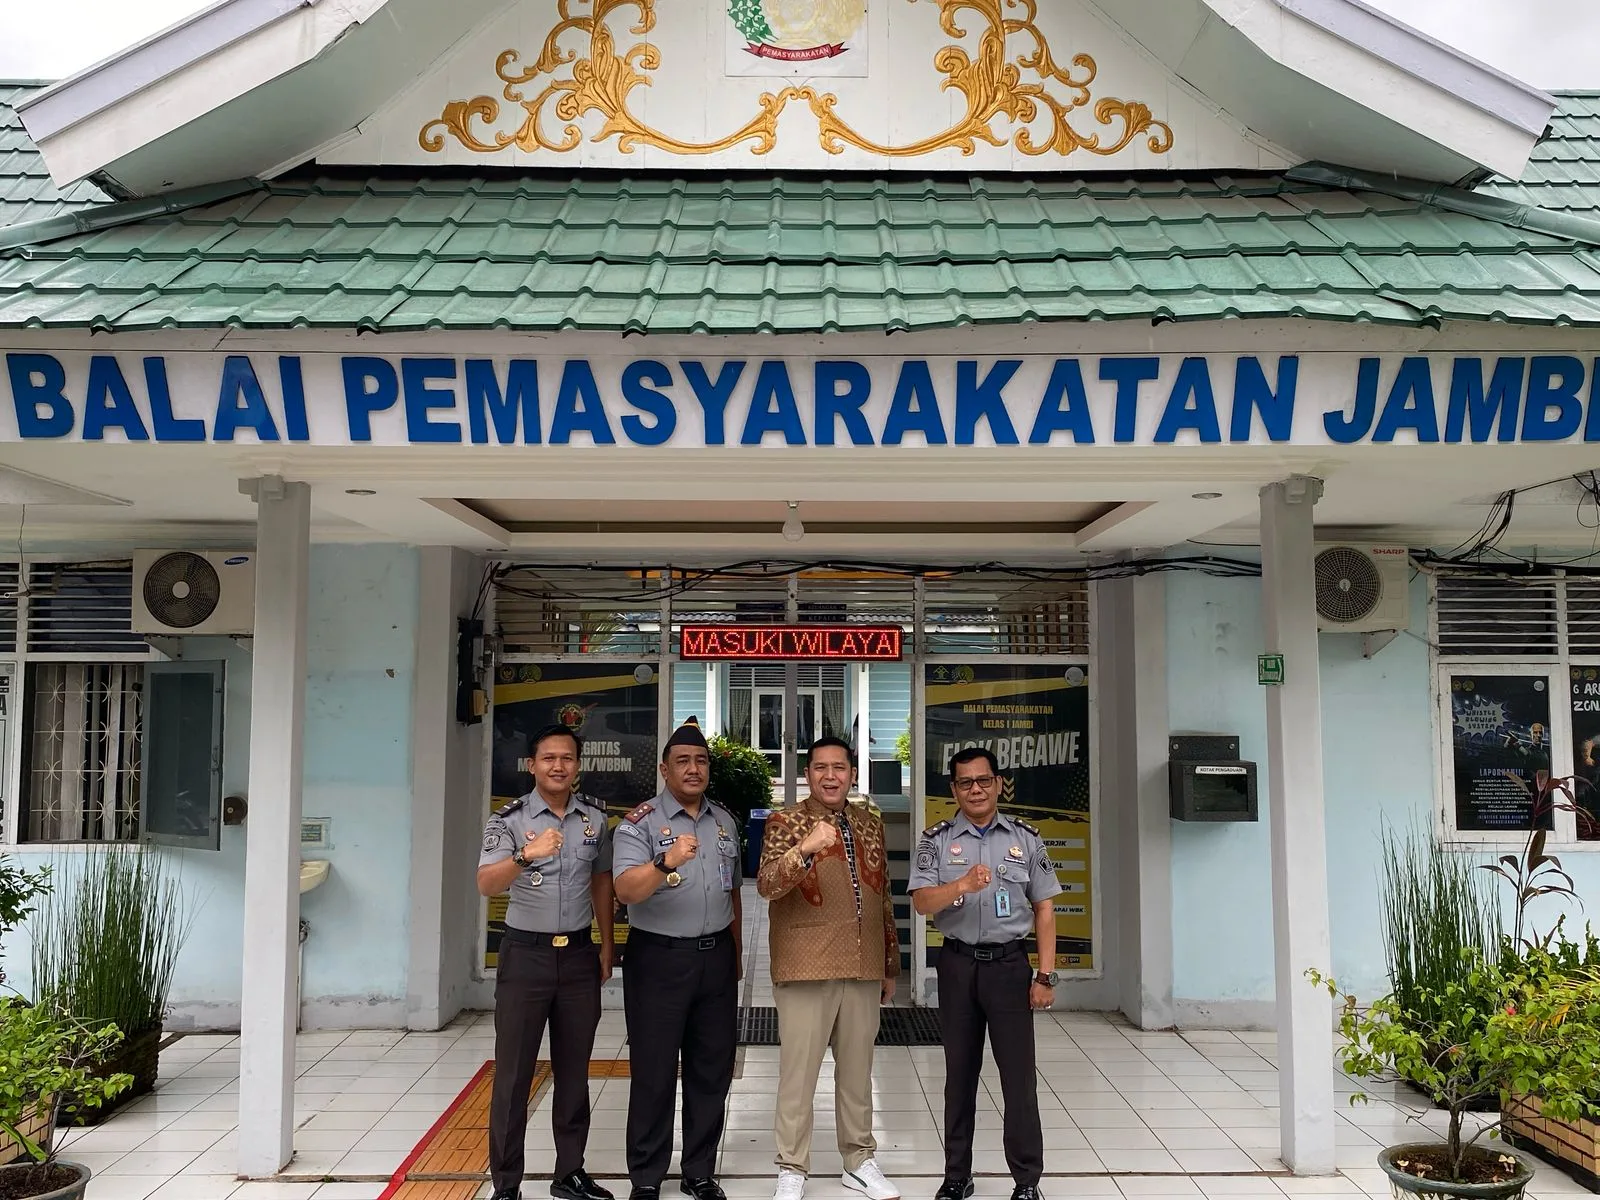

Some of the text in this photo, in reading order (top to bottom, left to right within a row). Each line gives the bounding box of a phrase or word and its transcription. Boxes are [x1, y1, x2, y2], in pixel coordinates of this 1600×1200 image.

[761, 46, 829, 59] PEMASYARAKATAN
[6, 353, 310, 441] BALAI
[341, 356, 1299, 446] PEMASYARAKATAN
[684, 632, 897, 654] MASUKI WILAYA
[963, 704, 1054, 715] BALAI PEMASYARAKATAN
[1573, 700, 1600, 712] ZON
[982, 719, 1005, 729] KELAS
[1011, 719, 1034, 729] JAMBI
[580, 740, 621, 756] GRITAS
[997, 731, 1081, 771] BEGAWE
